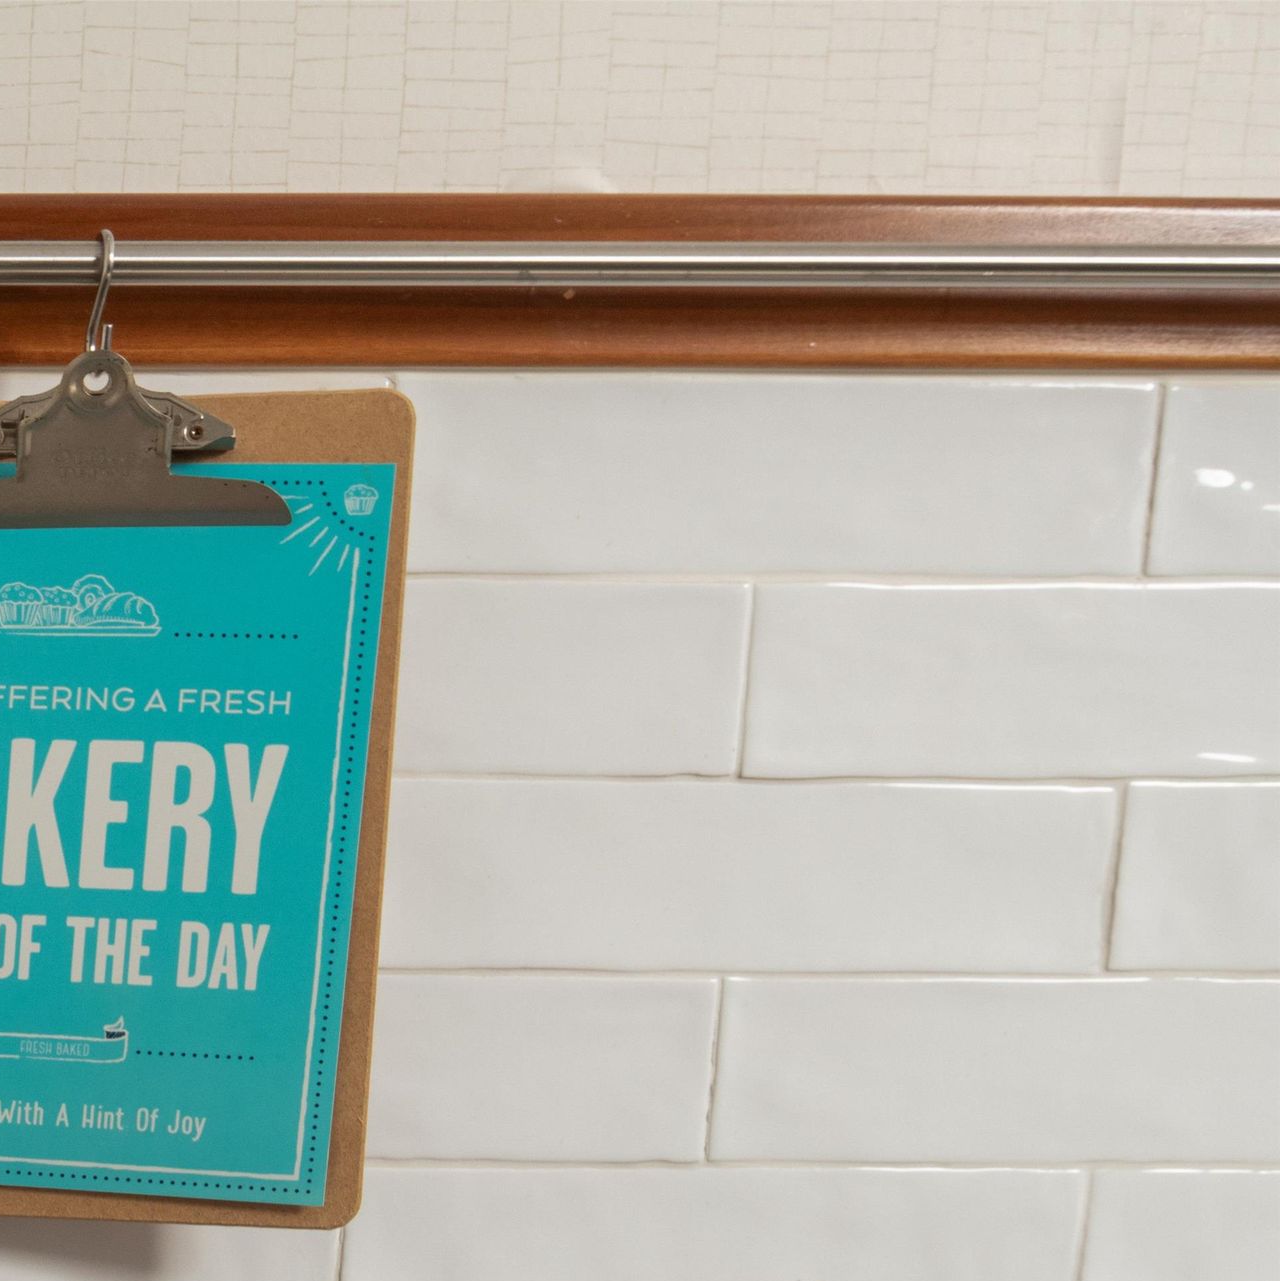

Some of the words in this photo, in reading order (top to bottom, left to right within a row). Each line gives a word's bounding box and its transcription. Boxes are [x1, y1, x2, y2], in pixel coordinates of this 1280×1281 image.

[145, 689, 166, 711] A
[178, 689, 291, 715] FRESH
[66, 916, 157, 986] THE
[176, 920, 270, 991] DAY
[19, 1040, 52, 1055] FRESH
[56, 1043, 90, 1057] BAKED
[56, 1103, 69, 1127] A
[81, 1104, 124, 1131] Hint
[136, 1107, 159, 1132] Of
[167, 1110, 206, 1142] Joy
